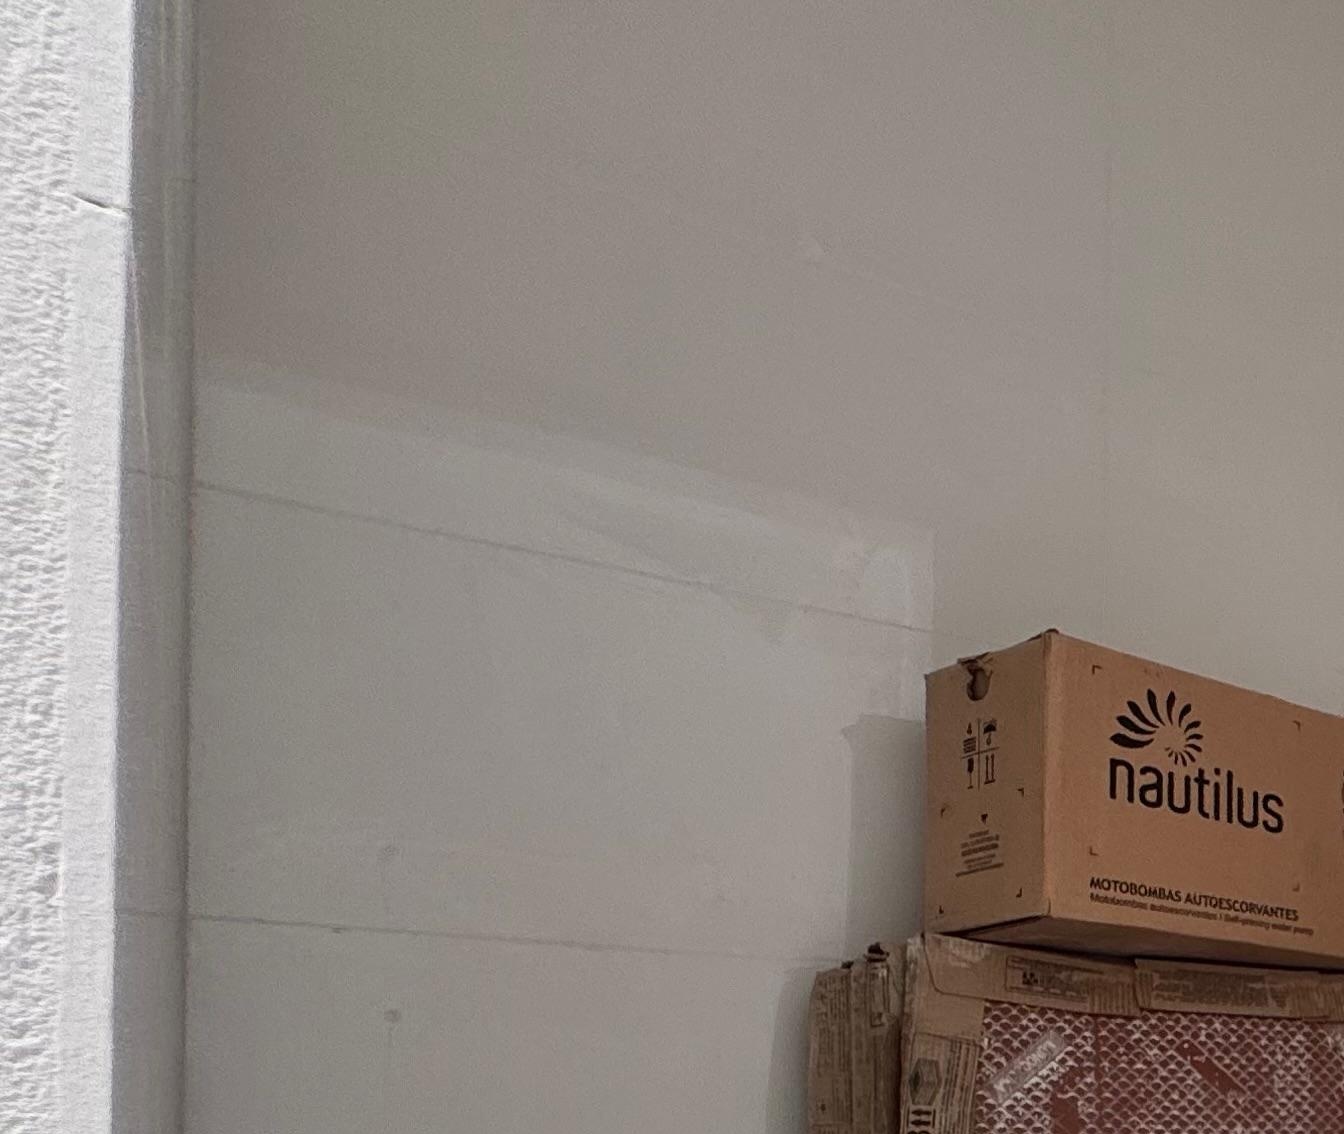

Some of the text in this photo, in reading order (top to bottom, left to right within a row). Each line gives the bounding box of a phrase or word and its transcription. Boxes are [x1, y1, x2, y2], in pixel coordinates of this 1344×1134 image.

[1109, 757, 1285, 834] nautilus
[1089, 877, 1299, 922] MOTOBOMBAS AUTOESCORVANTES
